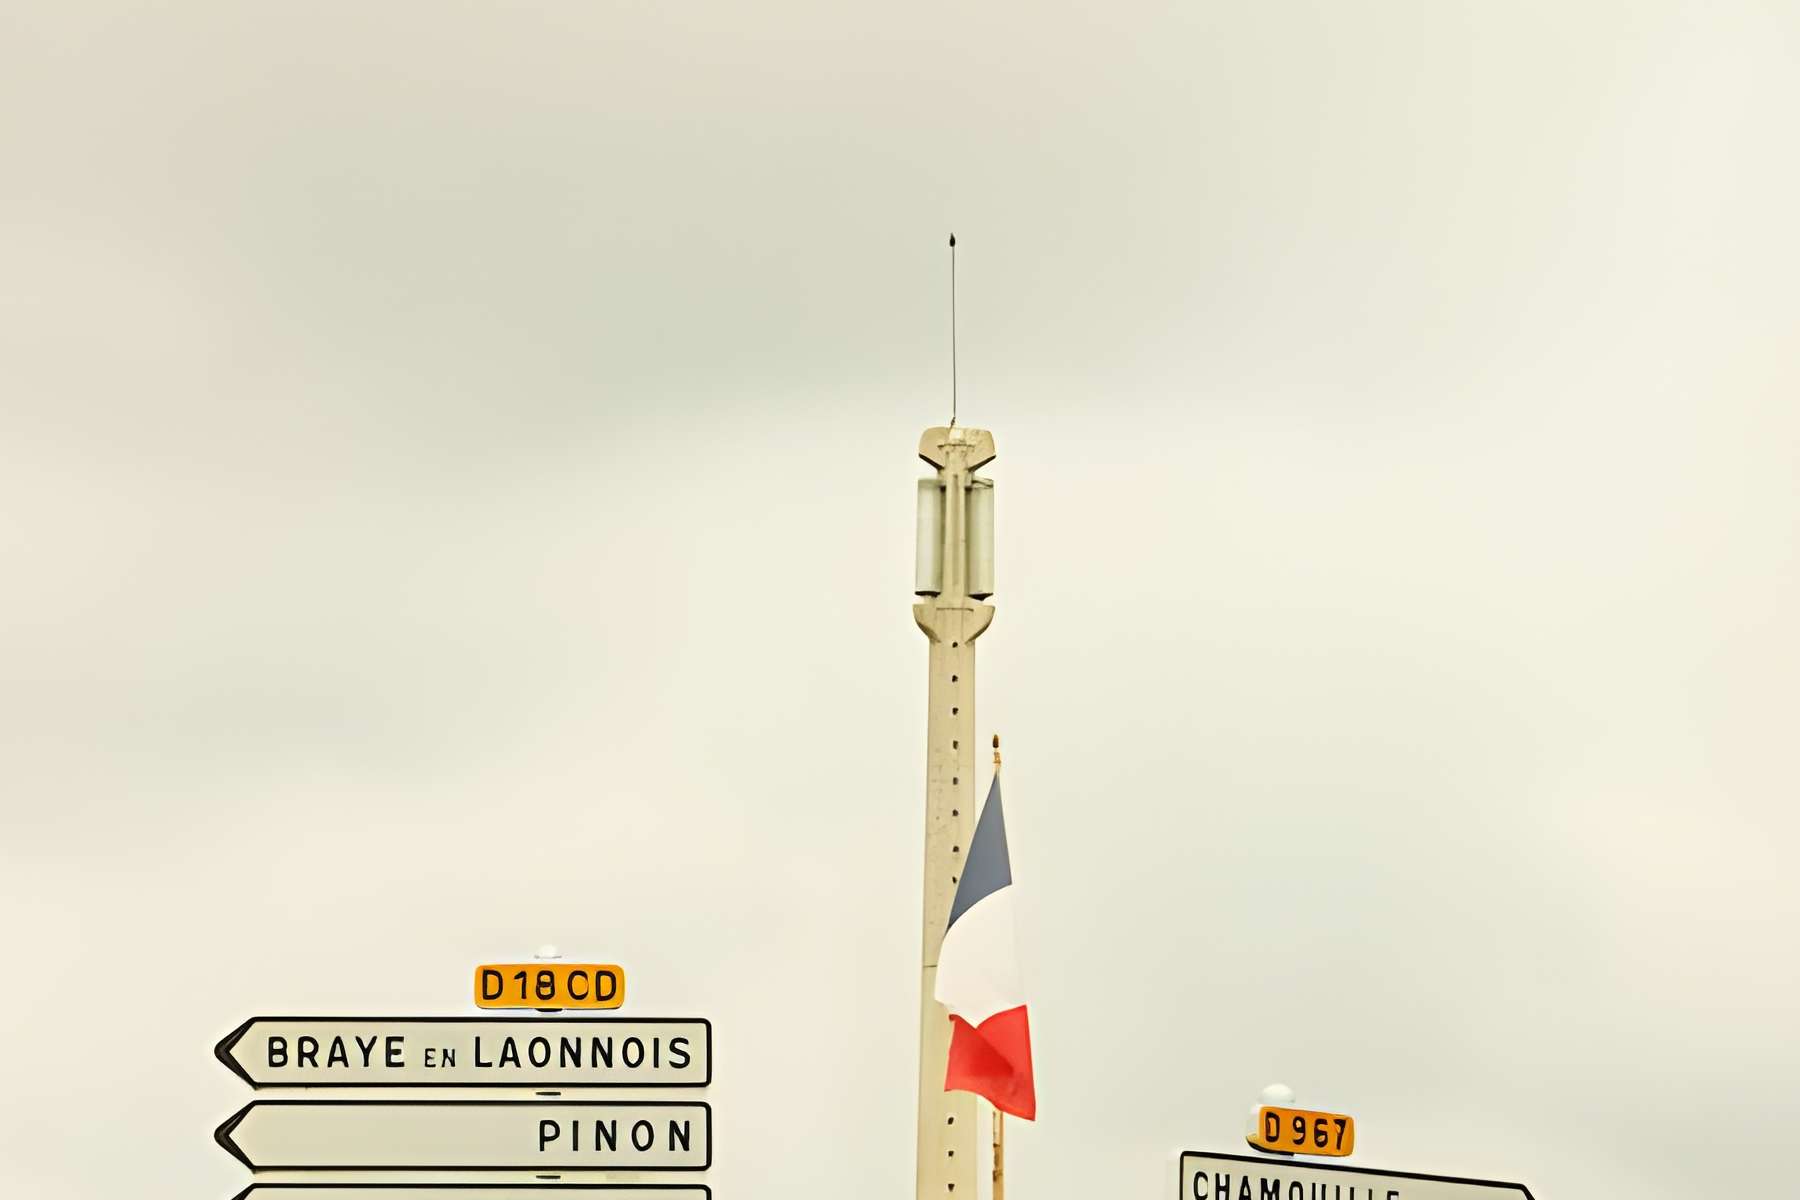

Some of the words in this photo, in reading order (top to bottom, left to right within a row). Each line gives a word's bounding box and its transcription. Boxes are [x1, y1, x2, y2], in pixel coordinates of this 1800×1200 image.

[268, 1036, 405, 1068] BRAYE
[425, 1048, 455, 1068] EN
[475, 1036, 690, 1069] LAONNOIS
[539, 1120, 690, 1151] PINON
[1293, 1116, 1347, 1150] 967
